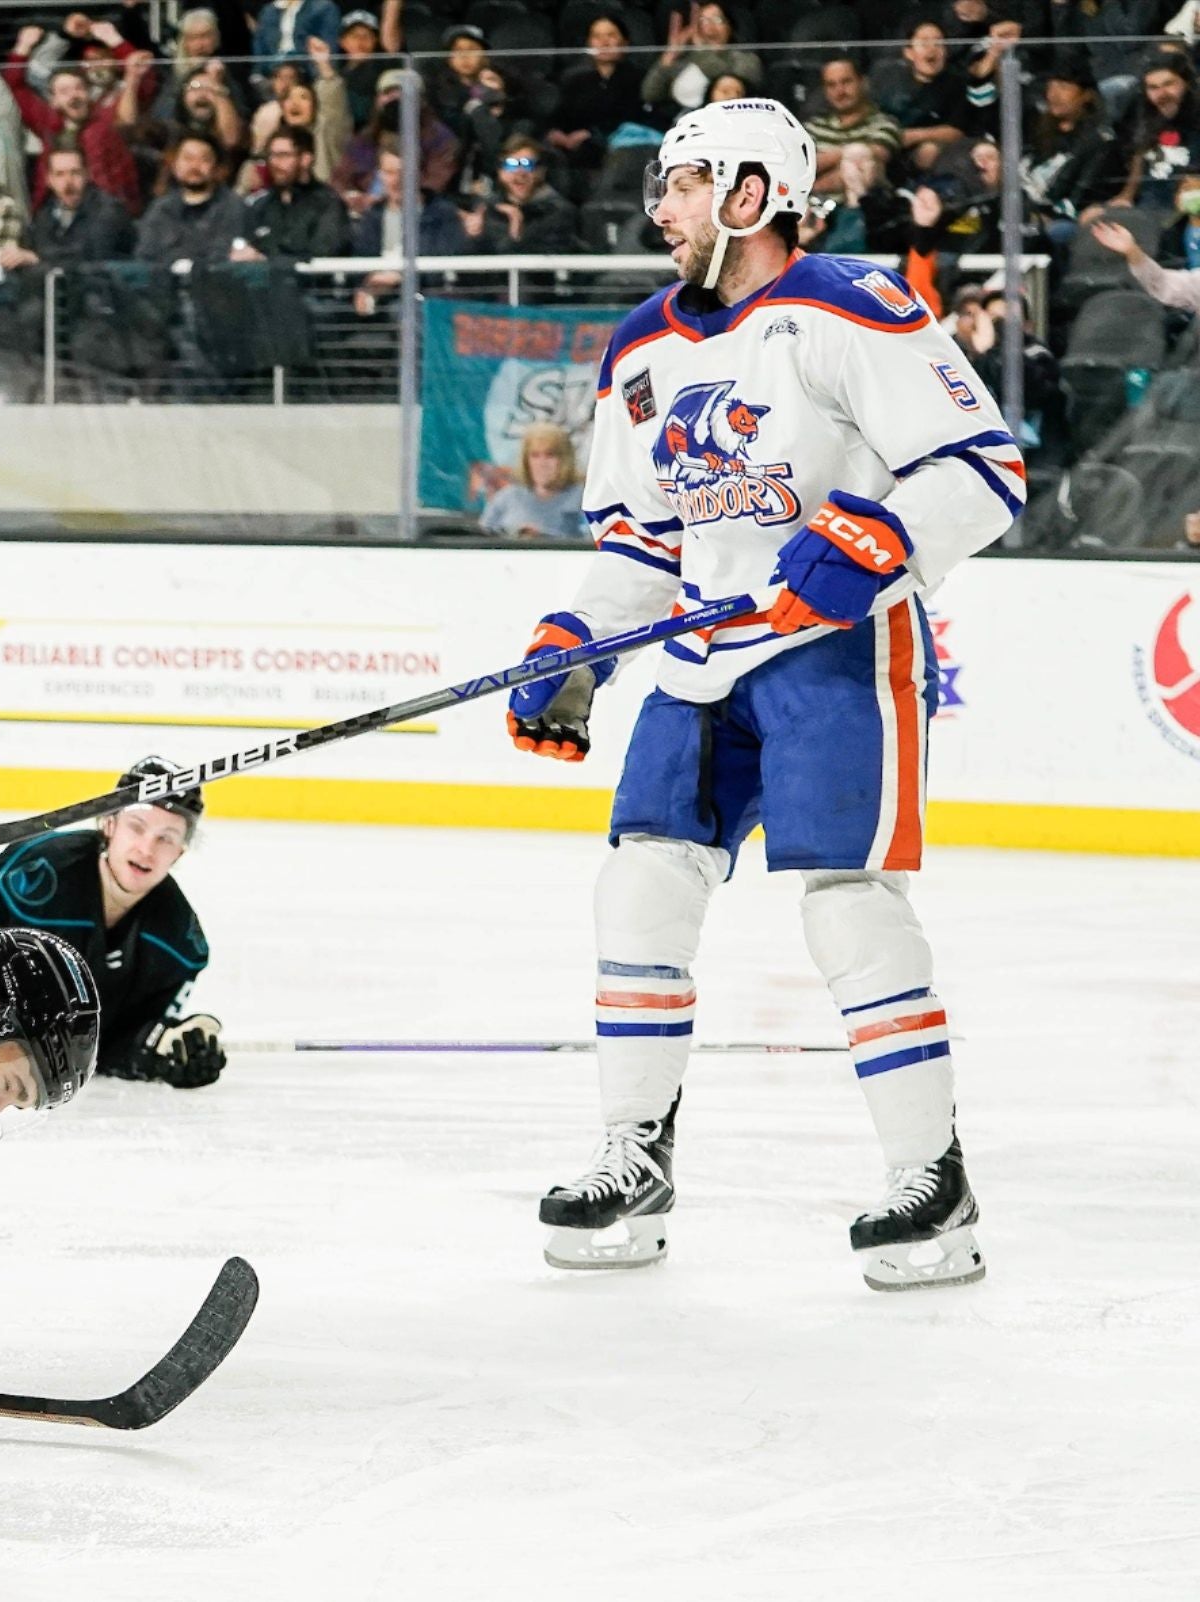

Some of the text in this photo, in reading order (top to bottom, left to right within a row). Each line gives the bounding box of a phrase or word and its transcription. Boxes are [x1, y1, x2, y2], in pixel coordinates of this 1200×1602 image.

[721, 103, 776, 112] WIRED
[930, 361, 980, 412] 5
[810, 508, 893, 567] CCM
[2, 643, 442, 675] RELIABLE CONCEPTS CORPORATION
